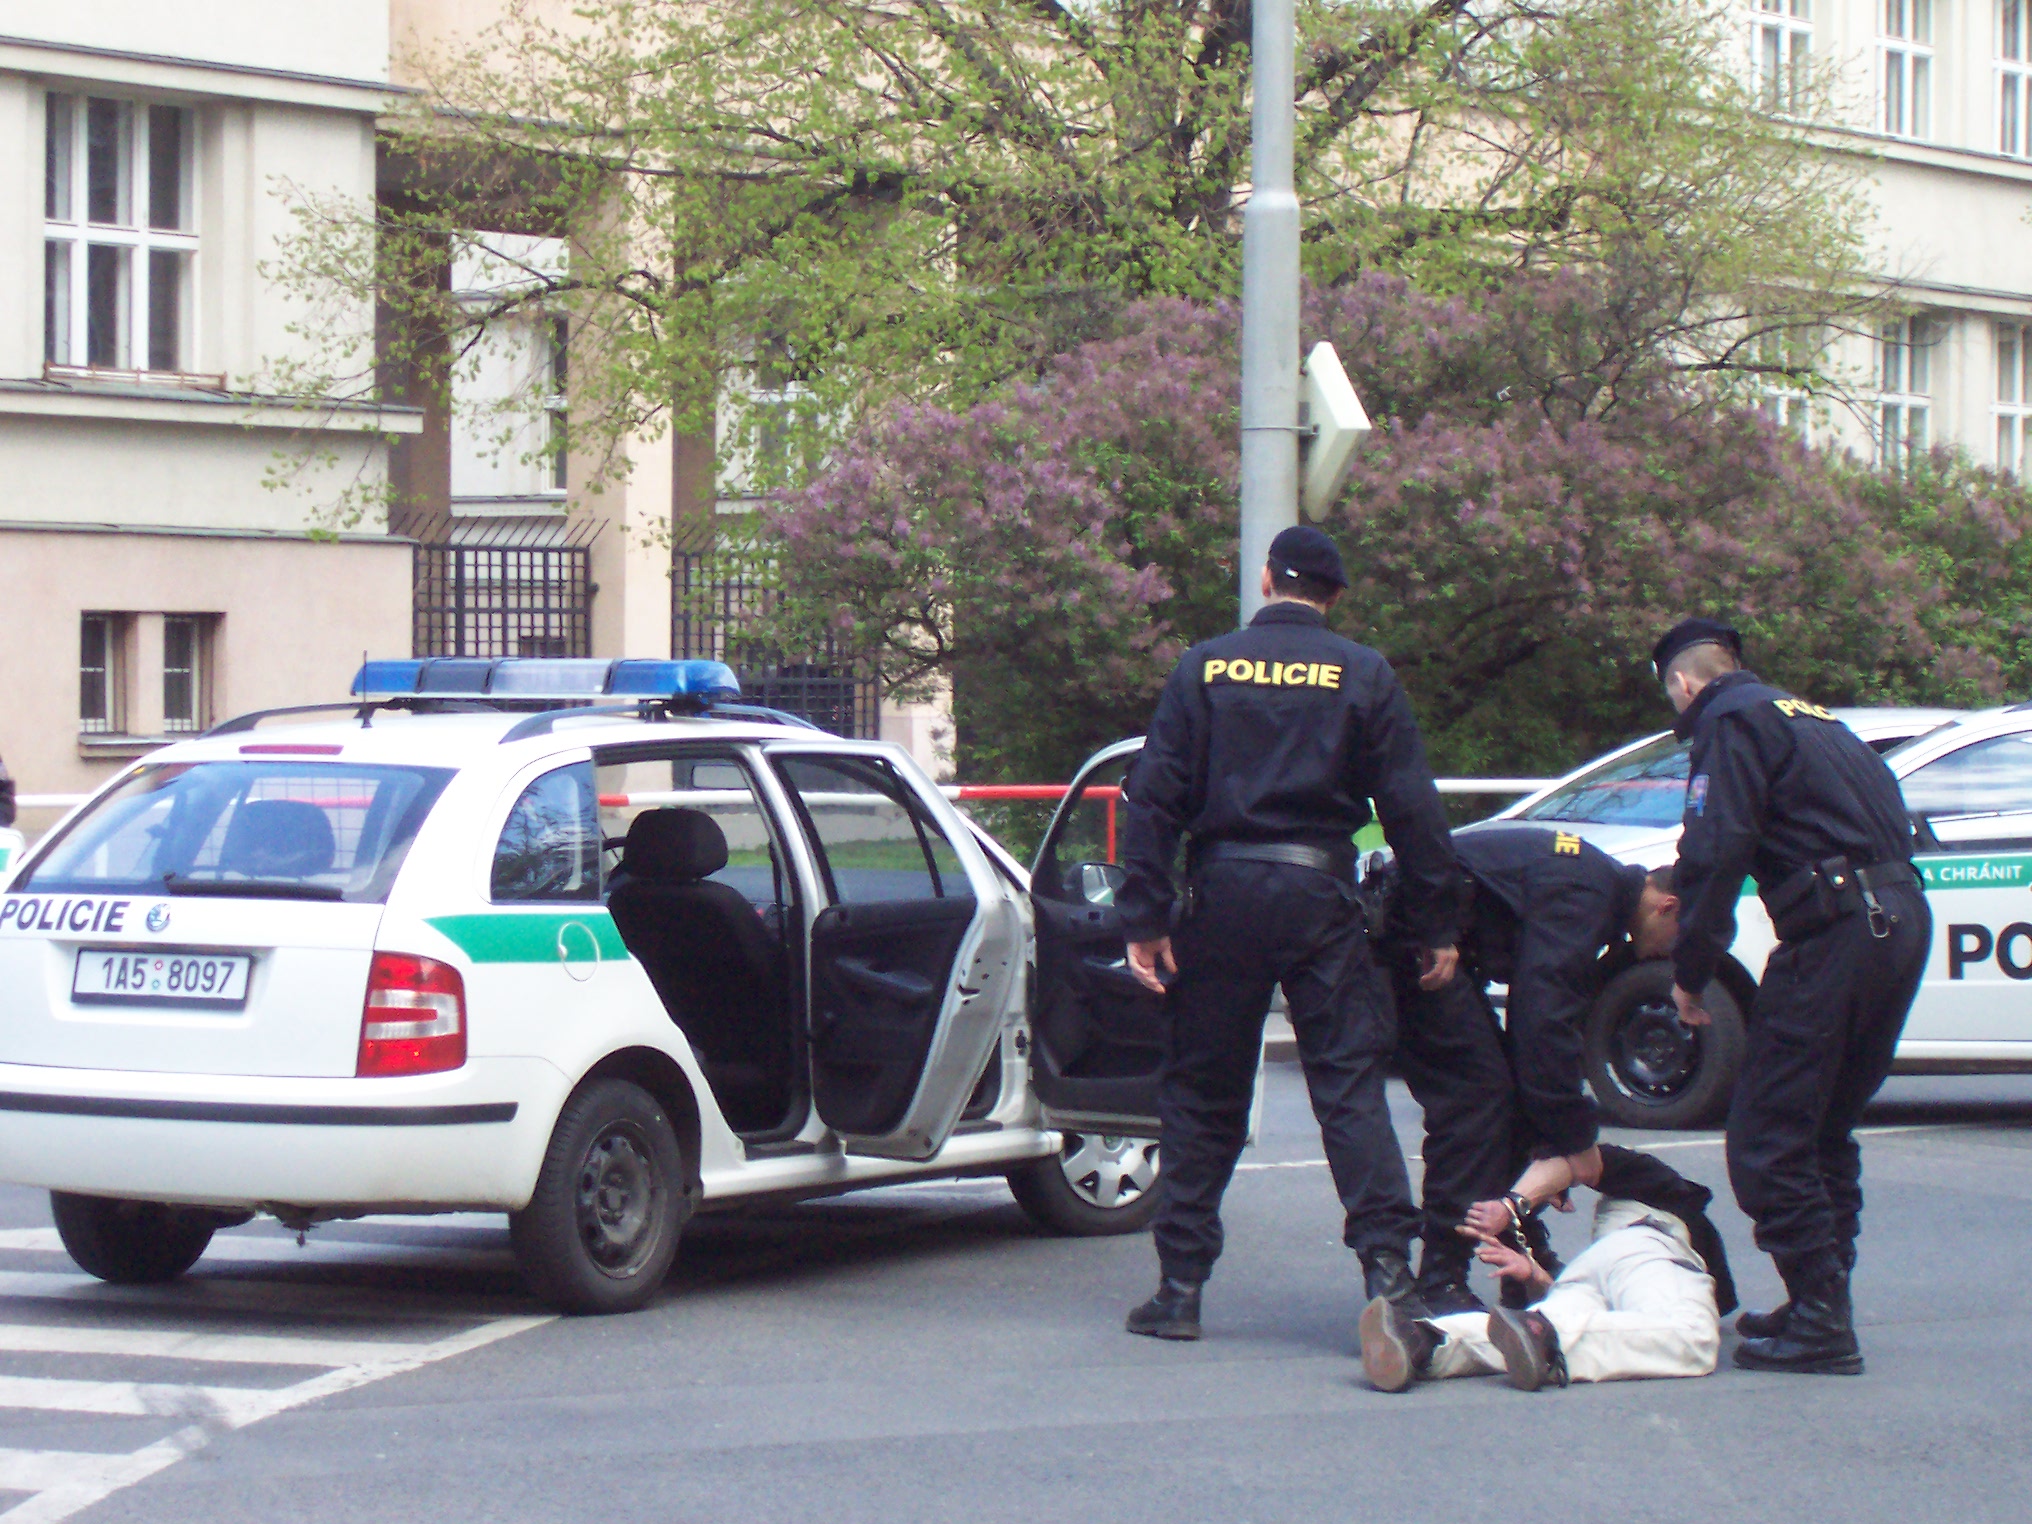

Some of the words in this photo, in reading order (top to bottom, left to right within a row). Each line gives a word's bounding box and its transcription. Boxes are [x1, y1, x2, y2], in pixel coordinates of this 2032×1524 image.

[1204, 659, 1343, 689] POLICIE
[1940, 862, 2023, 881] CHRÁNIT
[0, 898, 131, 932] POLICIE
[1948, 921, 2032, 981] PO
[102, 957, 149, 989] 1A5
[167, 959, 235, 993] 8097
